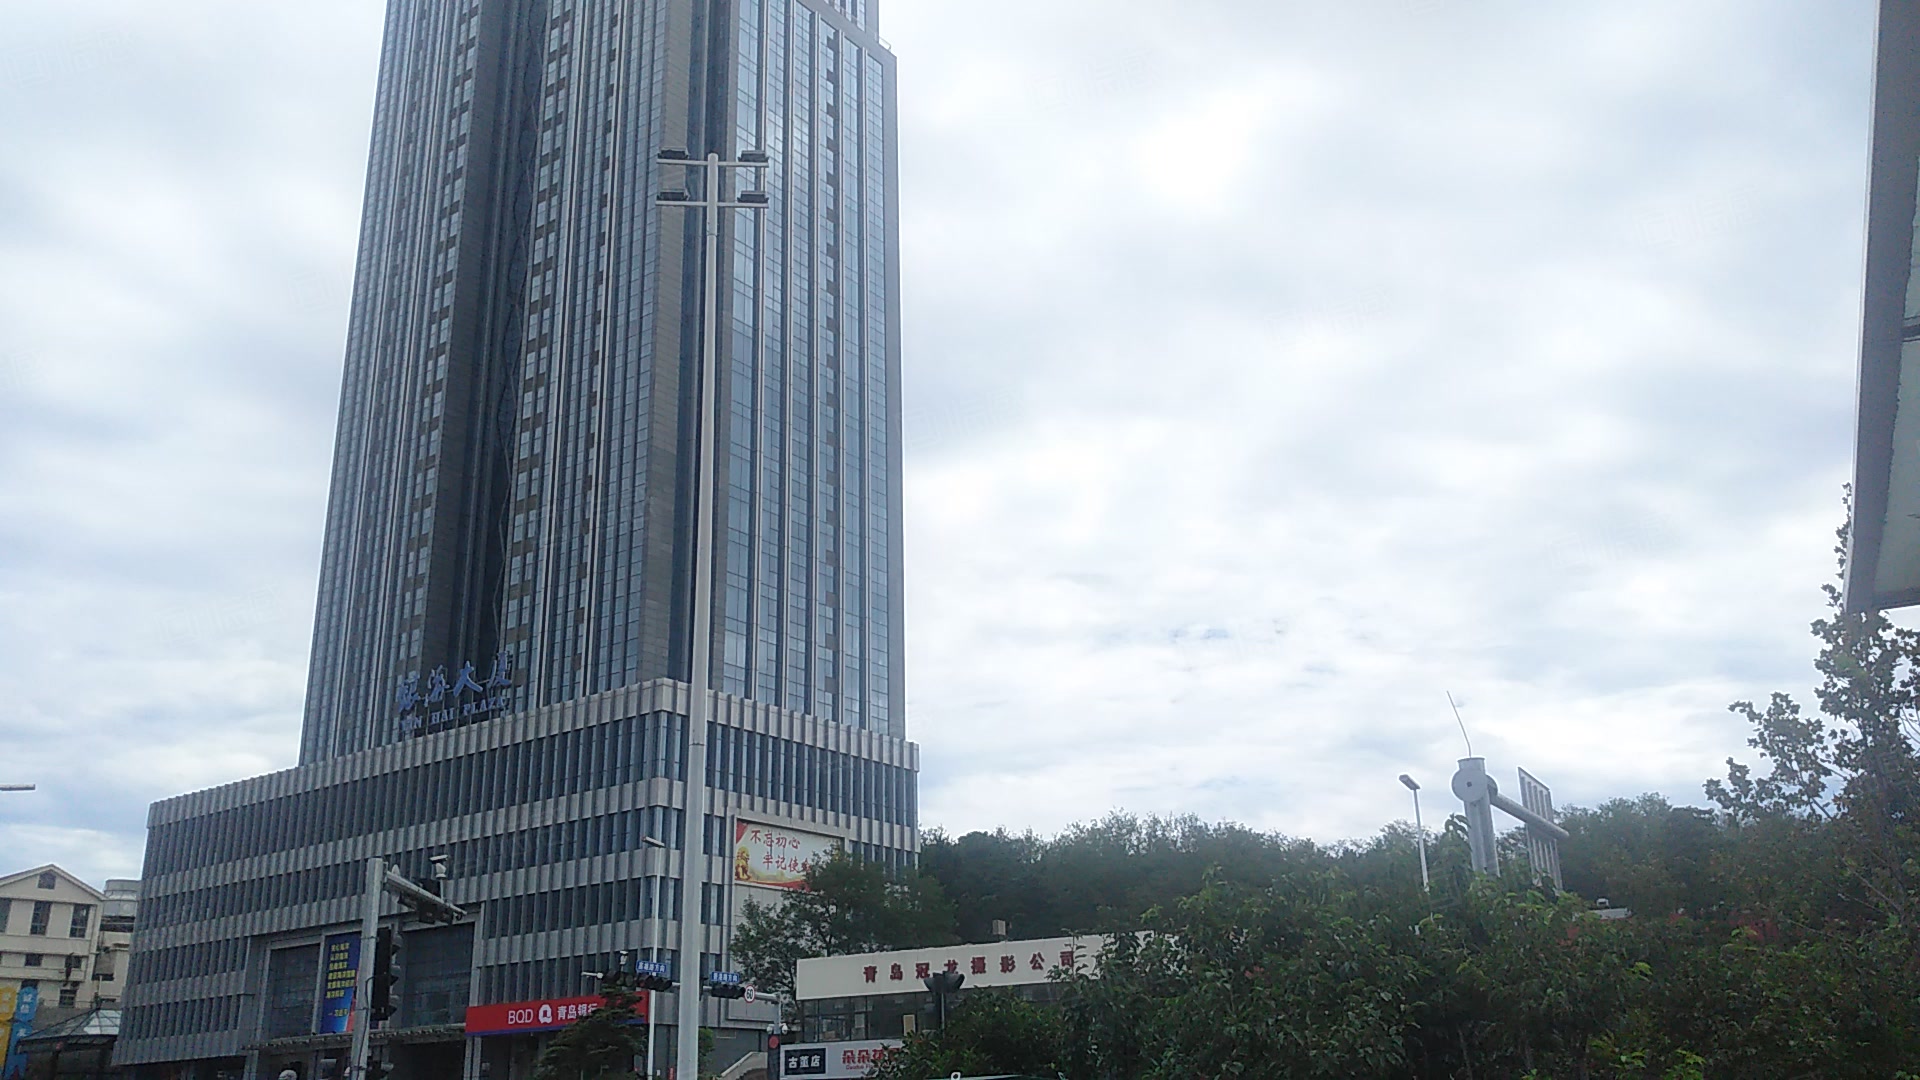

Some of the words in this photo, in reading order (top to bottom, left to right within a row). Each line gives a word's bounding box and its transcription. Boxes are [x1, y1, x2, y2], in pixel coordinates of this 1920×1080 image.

[750, 829, 801, 850] 不忘初心
[746, 988, 754, 1000] 60
[508, 1009, 534, 1024] BQD
[788, 1055, 821, 1069] 古董店
